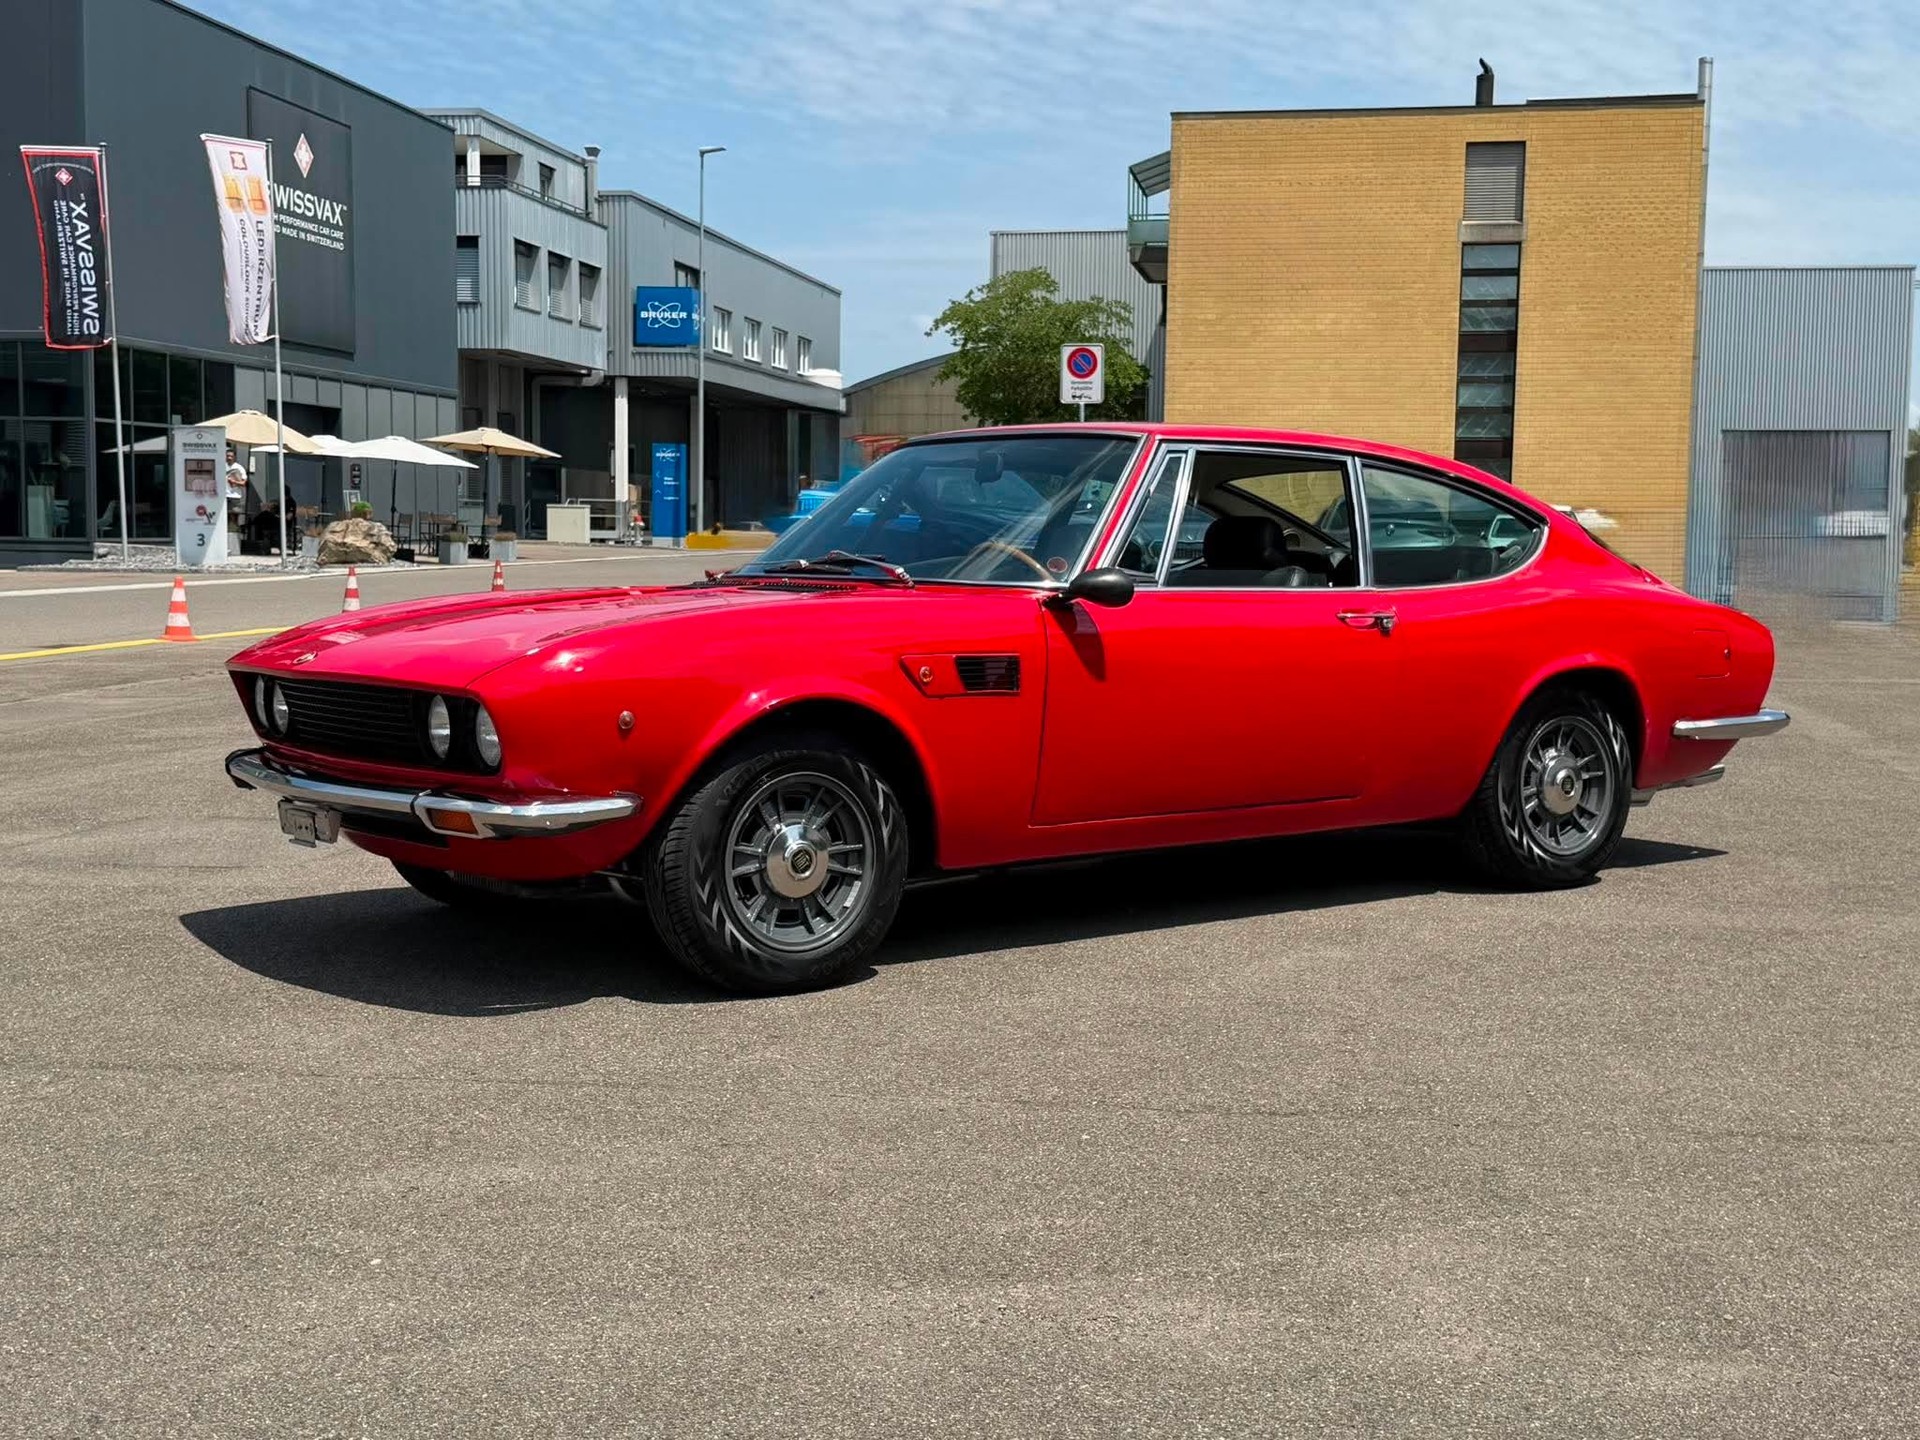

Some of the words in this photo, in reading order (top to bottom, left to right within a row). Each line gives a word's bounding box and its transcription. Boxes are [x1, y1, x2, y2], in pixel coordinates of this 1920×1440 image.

[280, 214, 318, 232] PERFORMANCE
[320, 225, 330, 235] CAR
[331, 229, 344, 240] CARE
[282, 226, 298, 238] MADE
[299, 231, 306, 240] IN
[306, 233, 344, 250] SWITZERLAND
[253, 220, 265, 336] LEDERZENTRUM
[640, 310, 688, 319] BRUKER
[196, 533, 206, 547] 3
